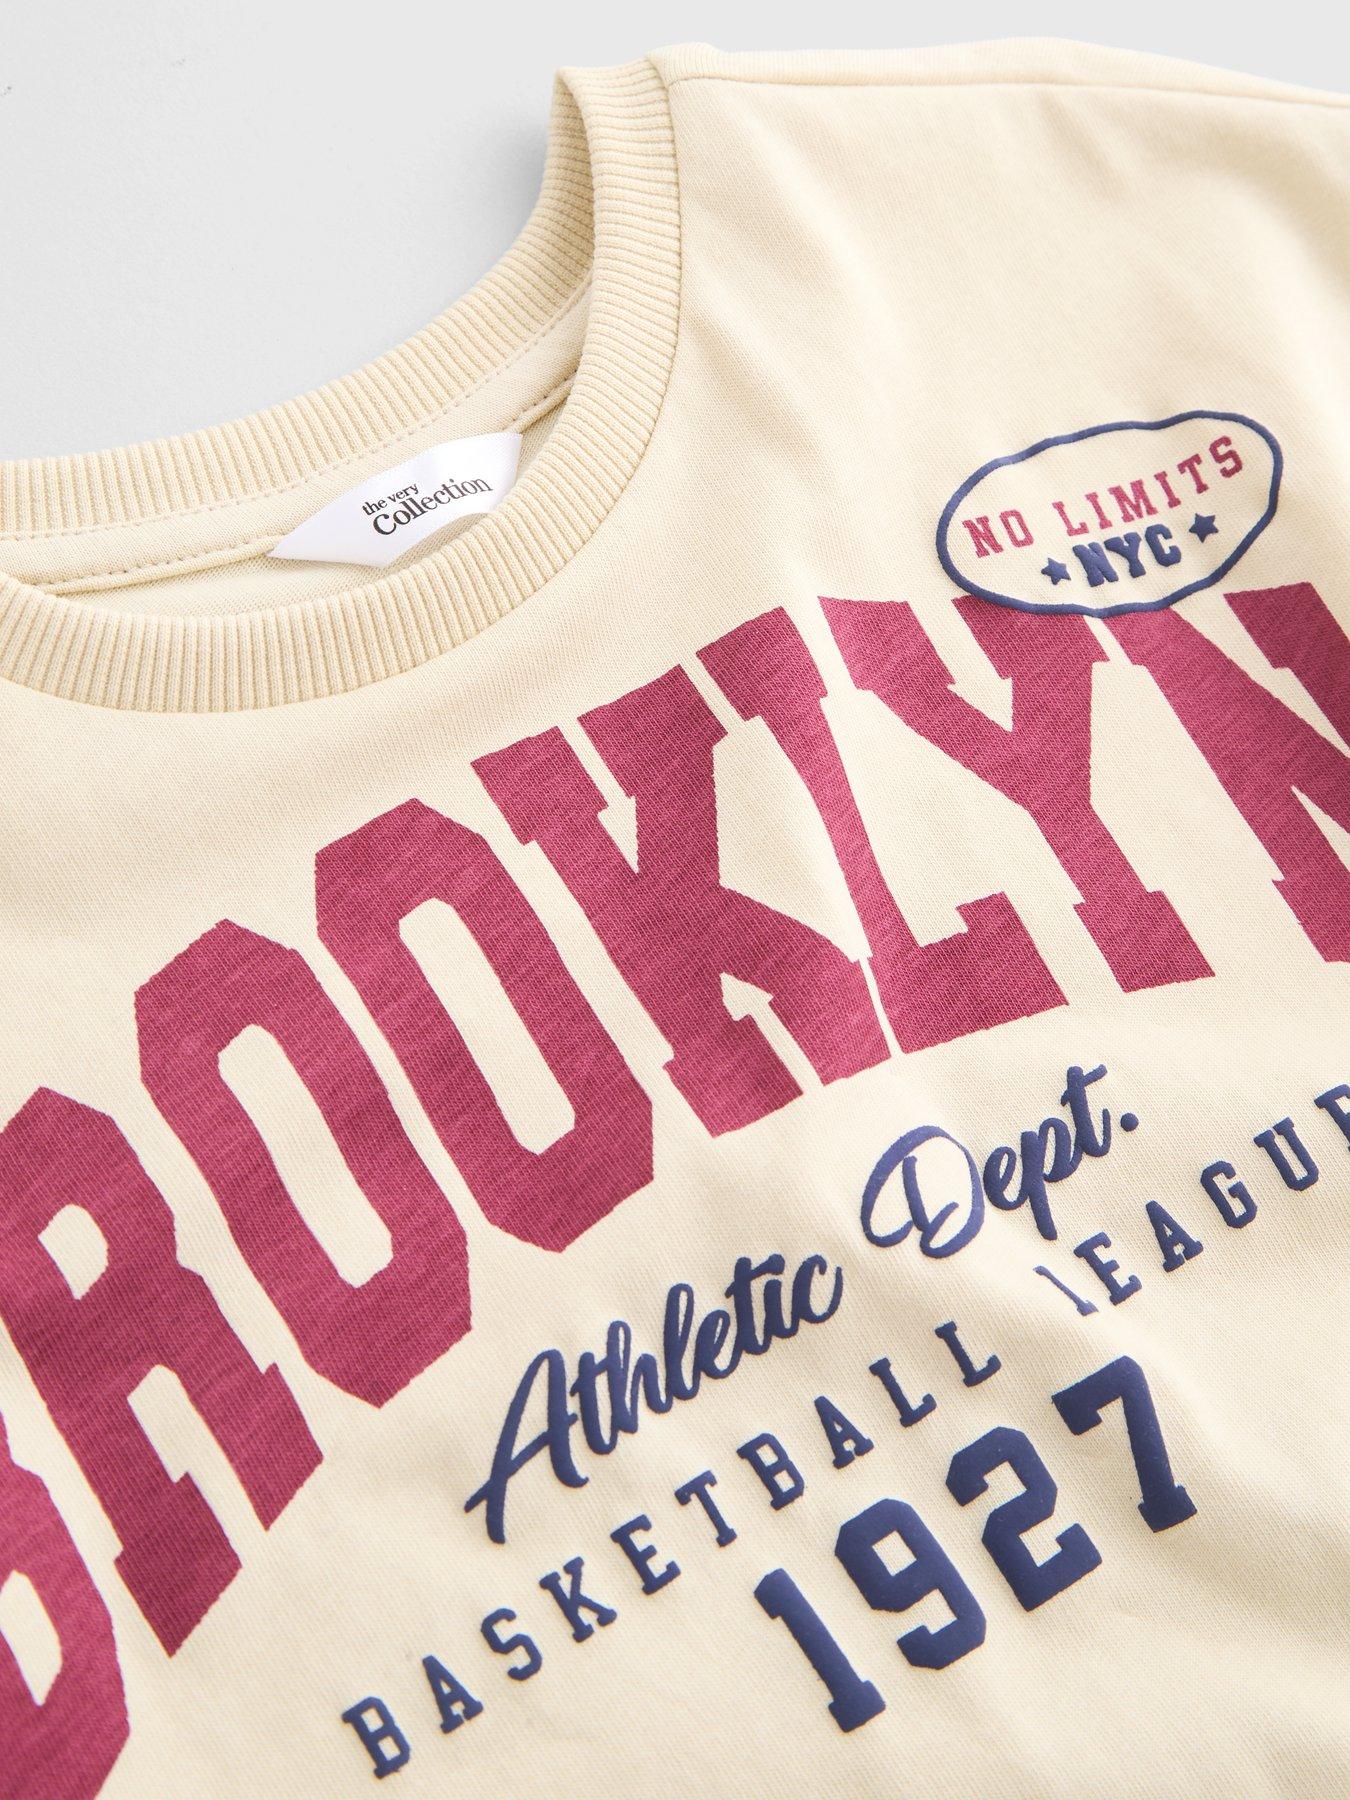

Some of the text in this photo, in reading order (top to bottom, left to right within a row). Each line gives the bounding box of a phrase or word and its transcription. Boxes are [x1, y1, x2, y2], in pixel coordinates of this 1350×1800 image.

[362, 483, 419, 516] the very
[373, 478, 493, 535] Collection
[962, 435, 1243, 558] NO LIMITS
[1073, 523, 1182, 587] NYC
[464, 1064, 1139, 1544] Athletic Dept.
[342, 1320, 1001, 1778] BASKETBALL
[754, 1355, 1198, 1733] 1927
